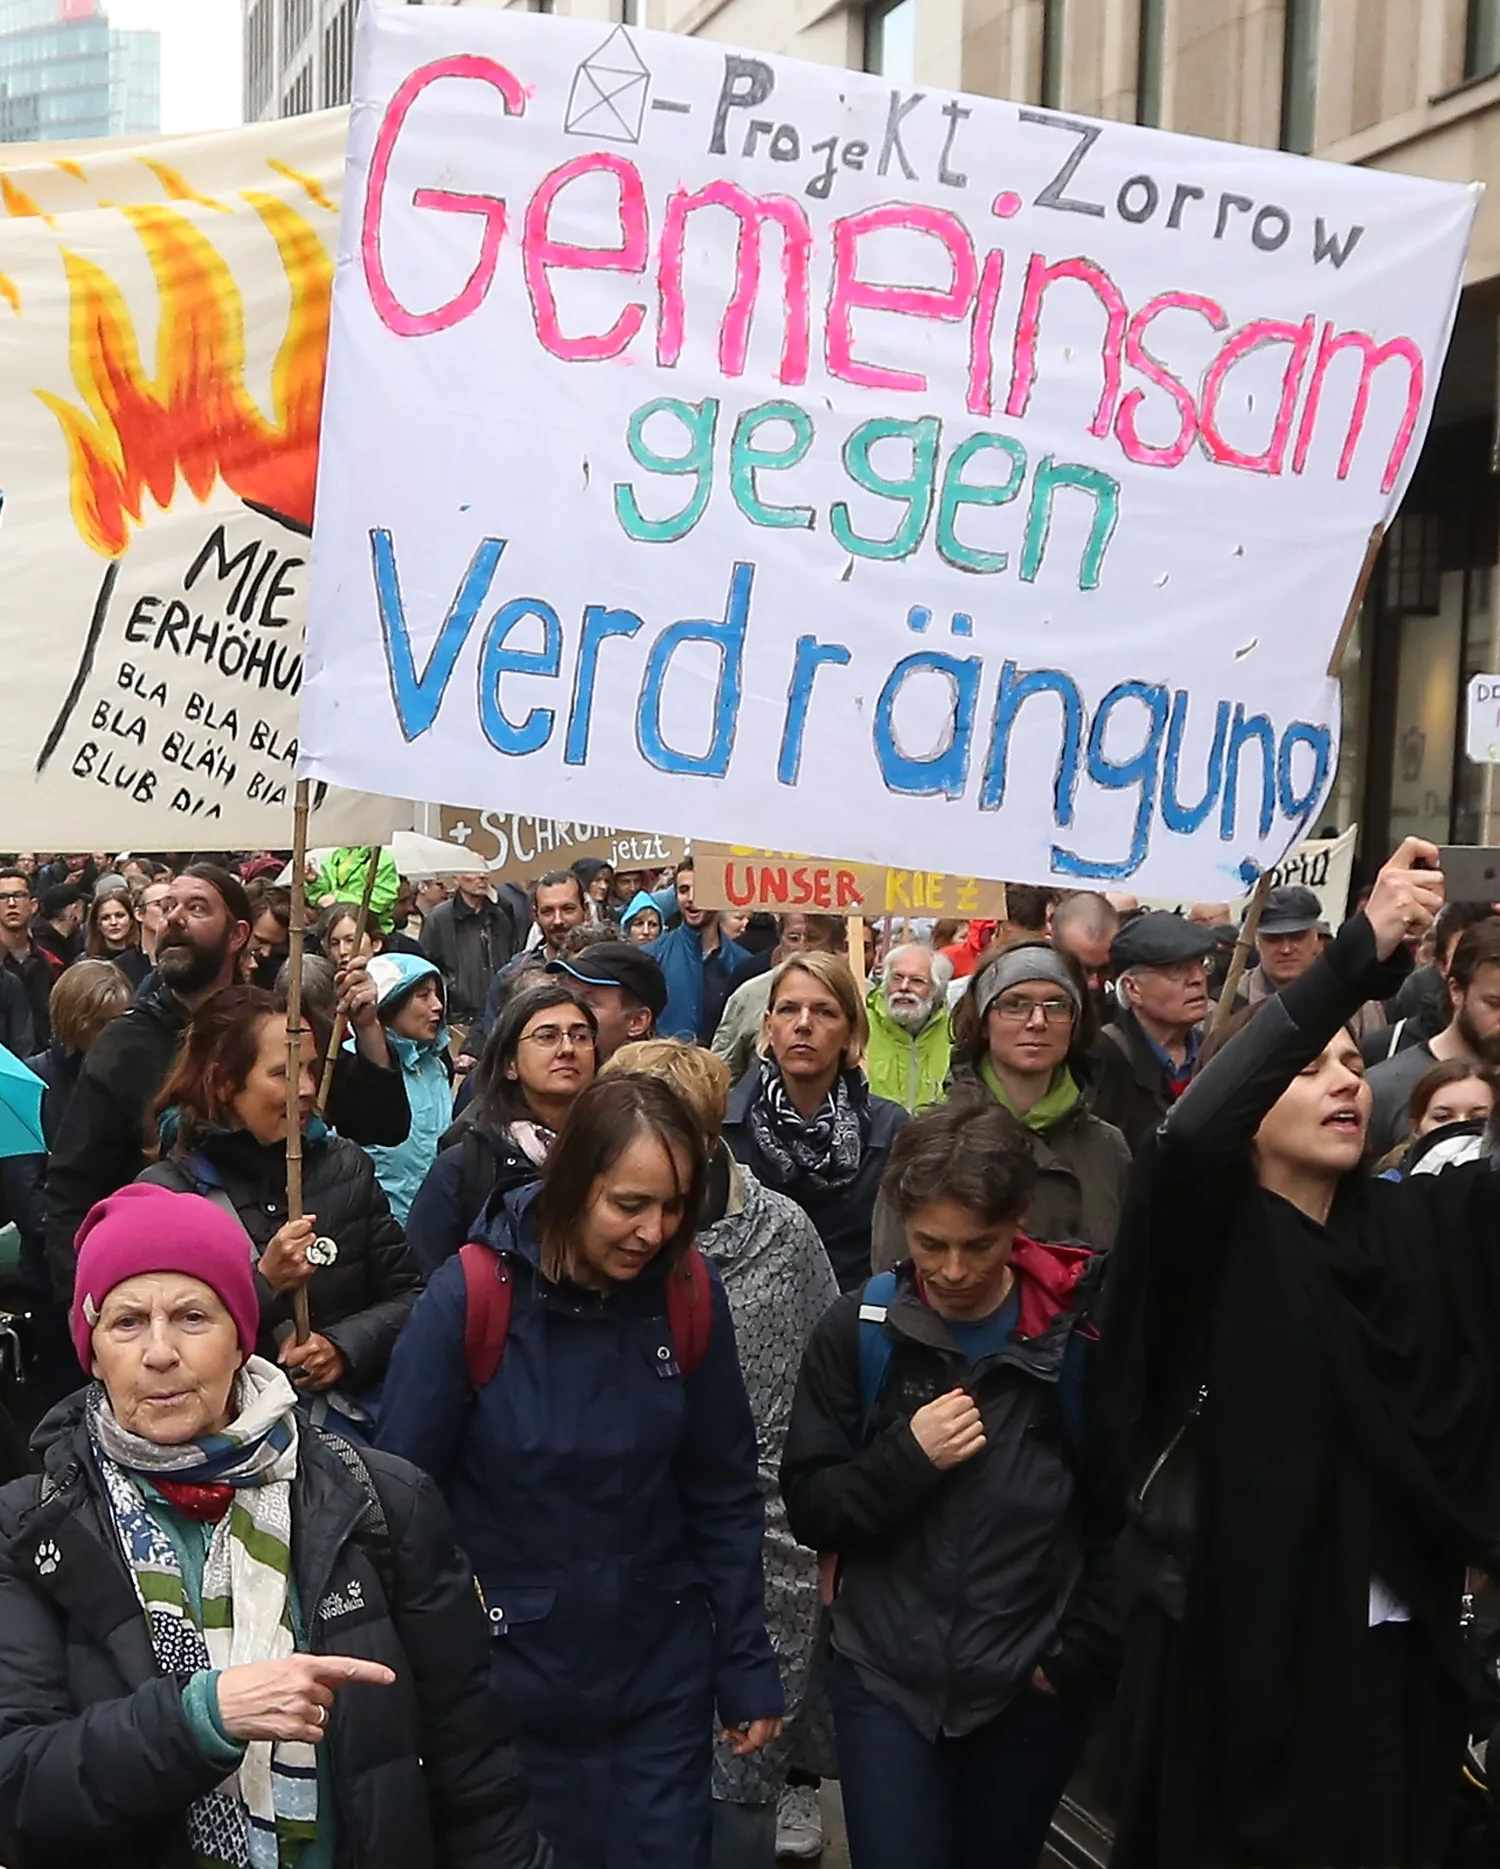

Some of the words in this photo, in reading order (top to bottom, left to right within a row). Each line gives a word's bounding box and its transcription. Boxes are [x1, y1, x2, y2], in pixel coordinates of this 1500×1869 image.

[1019, 110, 1367, 271] Zorrow
[361, 53, 1425, 493] Gemeinsam
[613, 396, 1121, 591] gegen
[184, 524, 306, 628] MIE
[91, 700, 147, 746] BLA
[161, 731, 237, 787] BLÄH
[117, 662, 168, 708] BLA
[184, 691, 239, 741] BLA
[249, 719, 299, 770] BLA
[368, 525, 1333, 882] Verdrängung
[71, 741, 158, 803] BLUB
[607, 835, 671, 868] jetzt
[724, 861, 865, 907] UNSER
